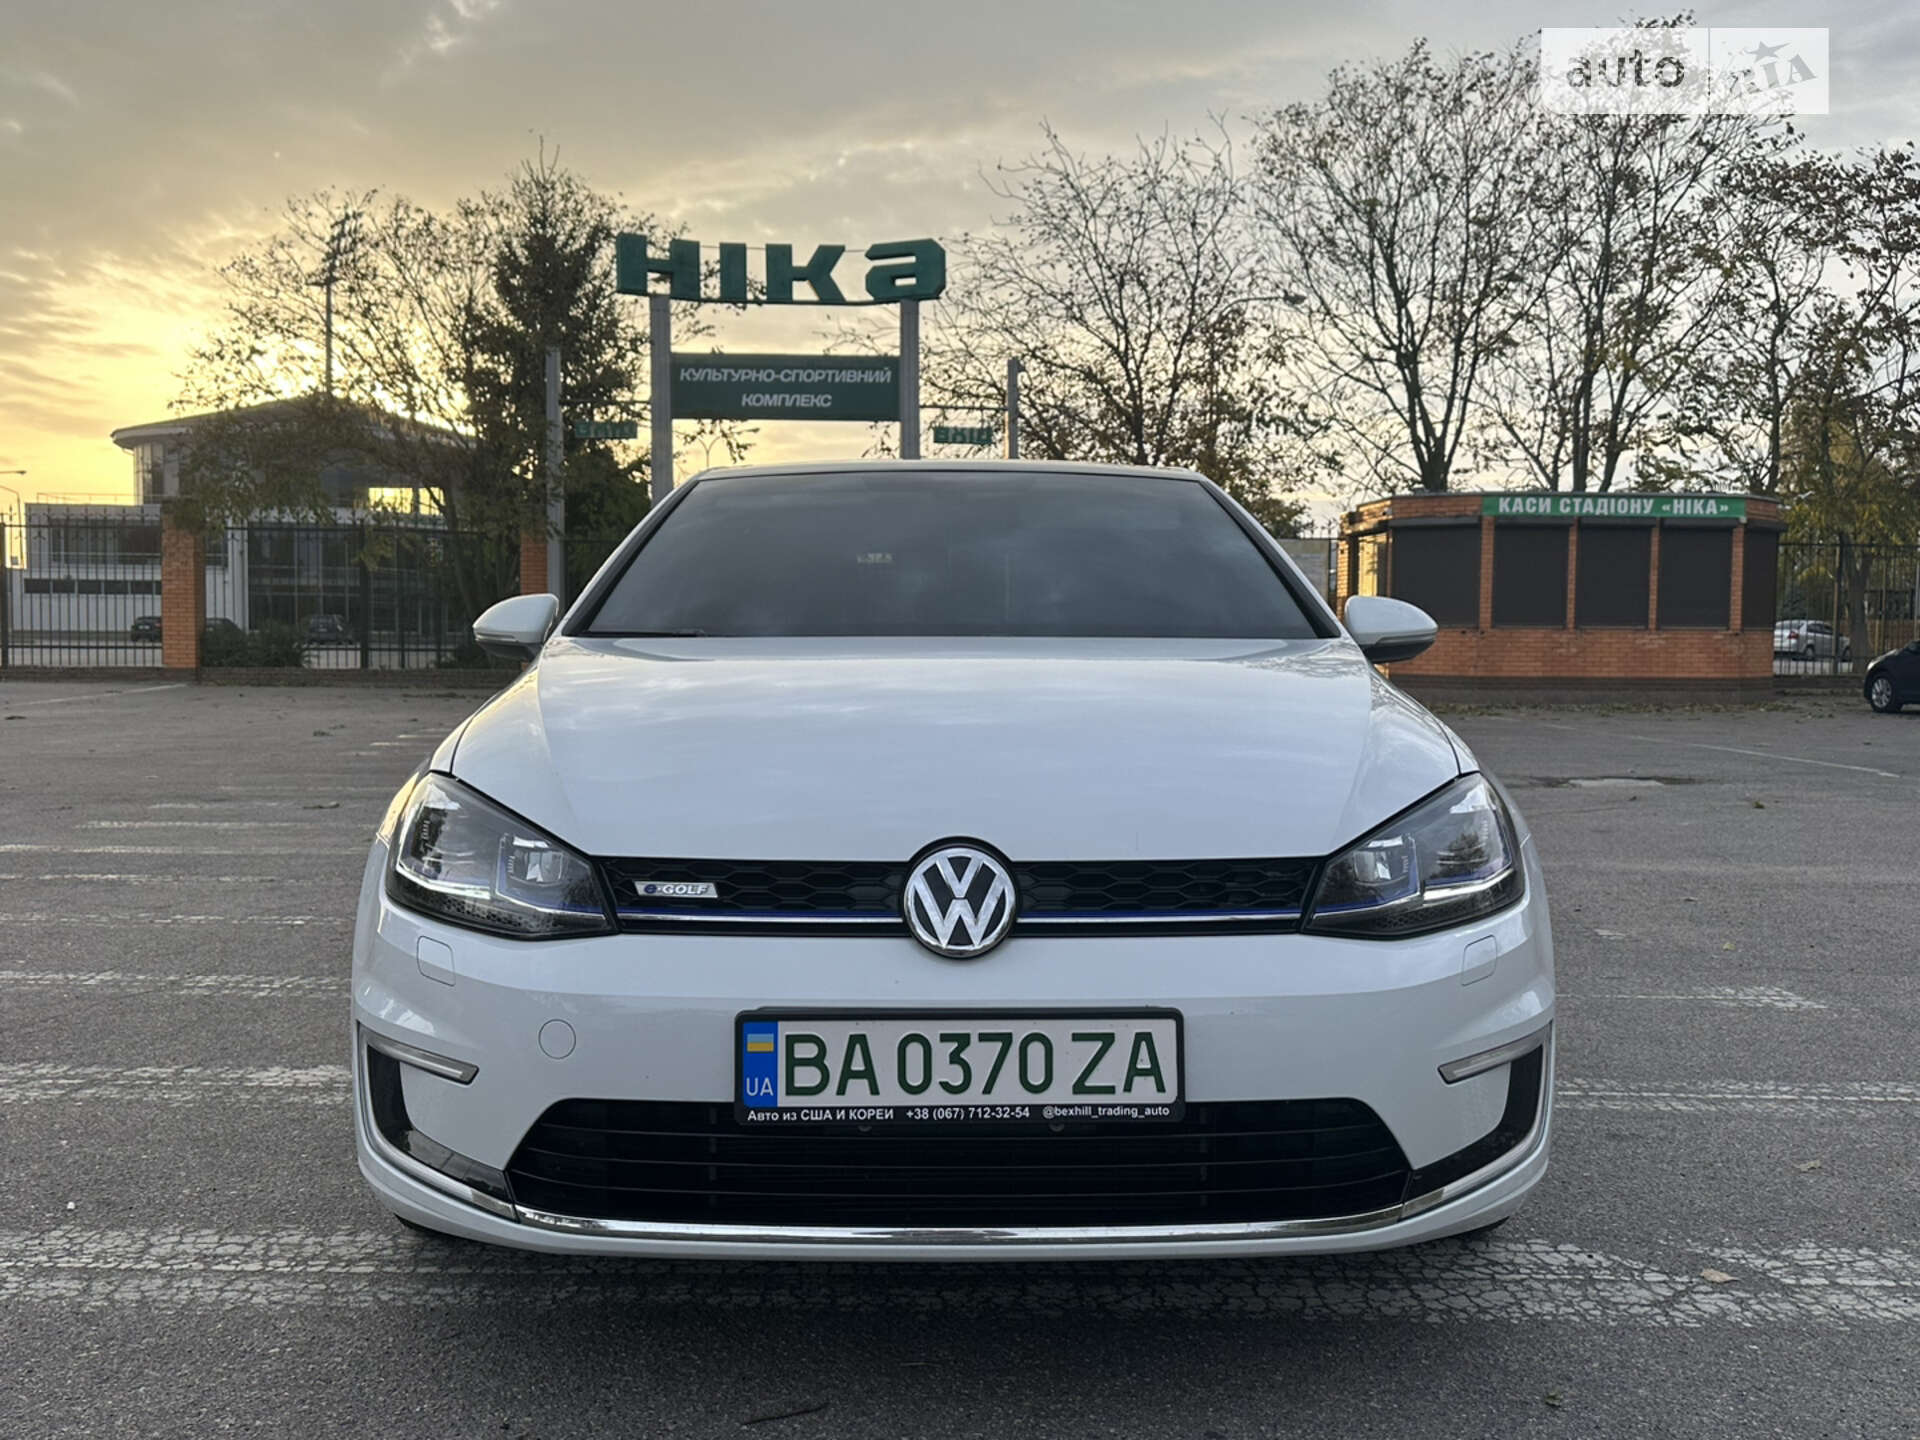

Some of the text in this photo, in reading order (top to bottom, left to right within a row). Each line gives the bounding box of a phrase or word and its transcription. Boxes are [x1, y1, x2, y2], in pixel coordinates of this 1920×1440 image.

[680, 367, 892, 383] КУЛЬТУРНО-СПОРТИВНИЙ
[742, 393, 833, 407] КОМПЛЕКС
[1498, 497, 1551, 513] КАСИ
[1559, 498, 1654, 515] СТАДІОНУ
[784, 1031, 1167, 1097] BA 0370 ZA
[745, 1077, 774, 1097] UA
[747, 1110, 779, 1121] Авто
[783, 1112, 797, 1121] из
[800, 1109, 833, 1121] США
[836, 1109, 845, 1121] И
[906, 1106, 1030, 1121] +38 (067) 712-32-54
[1042, 1105, 1170, 1119] @bexhill_trading_auto
